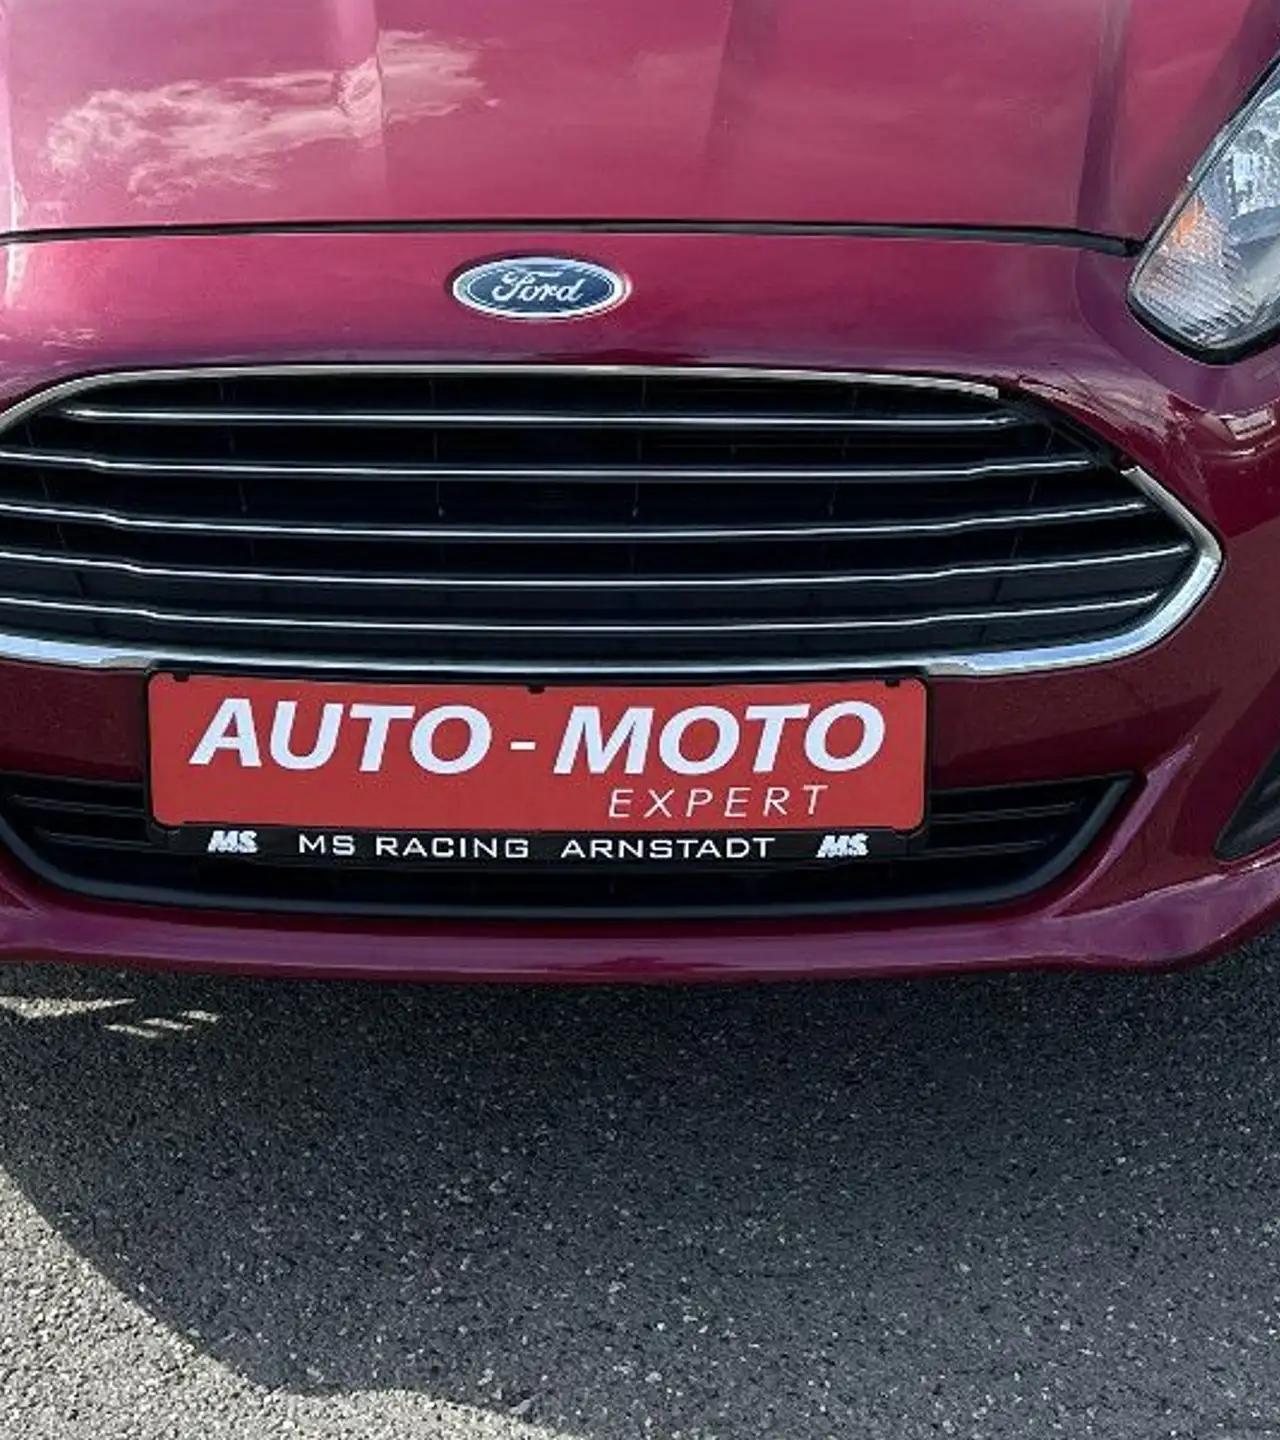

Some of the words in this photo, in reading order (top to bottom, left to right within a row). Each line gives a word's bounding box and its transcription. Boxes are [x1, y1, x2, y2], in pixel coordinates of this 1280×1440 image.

[491, 271, 586, 302] Ford
[189, 697, 493, 775] AUTO
[553, 700, 886, 776] MOTO
[608, 784, 828, 818] EXPERT
[208, 830, 258, 854] MS
[299, 834, 355, 856] MS
[375, 837, 529, 858] RACING
[561, 837, 776, 858] ARNSTADT
[816, 832, 869, 858] MS
